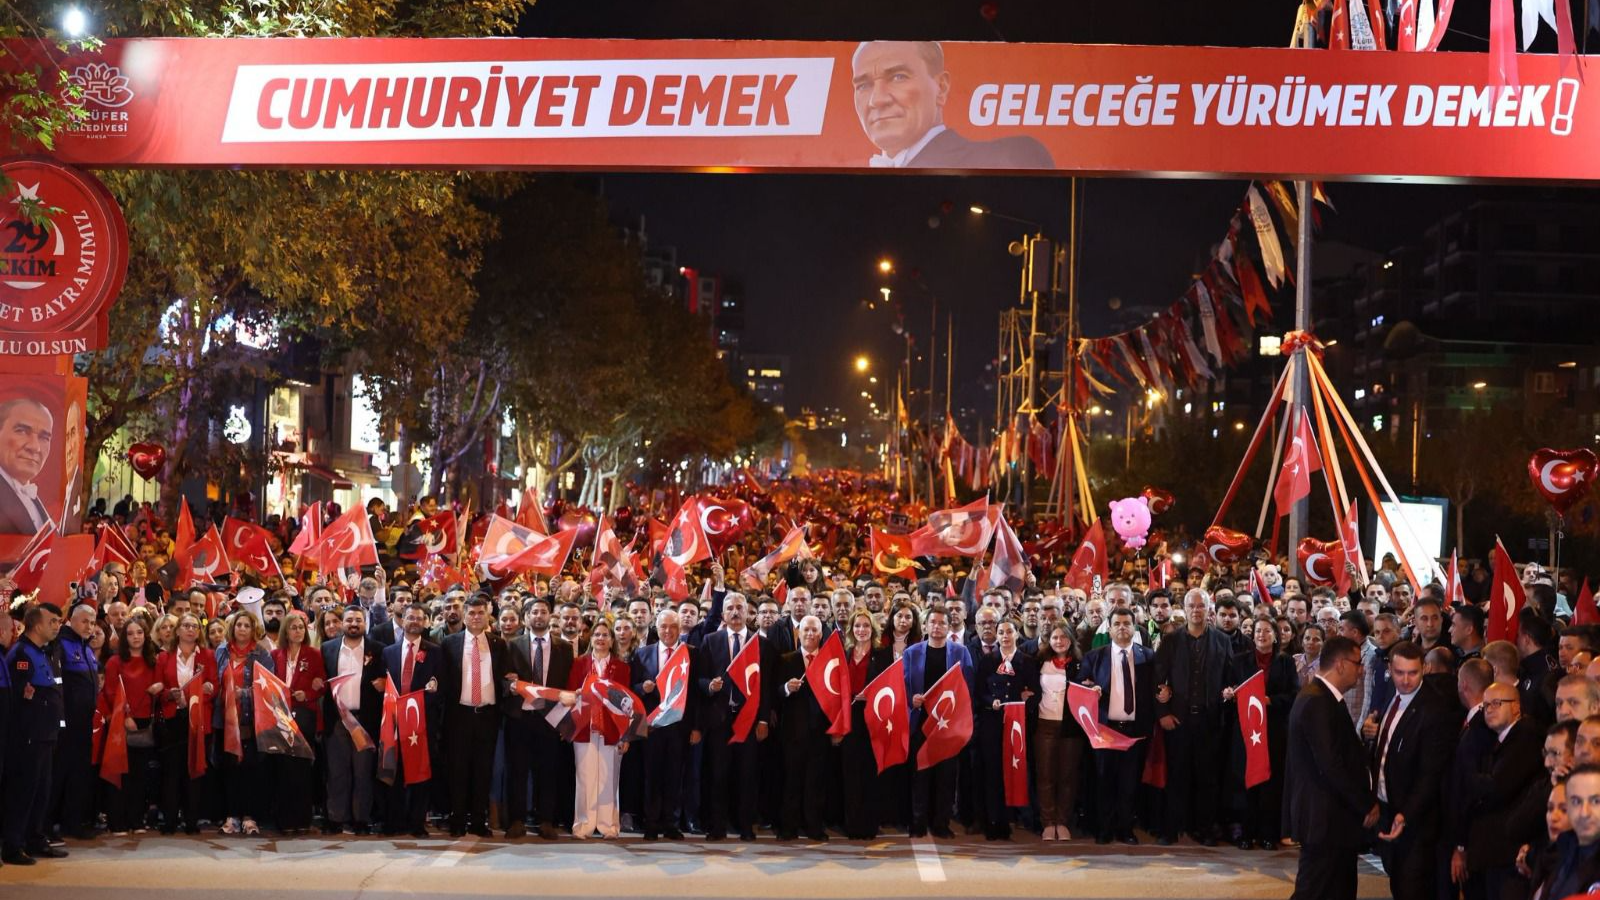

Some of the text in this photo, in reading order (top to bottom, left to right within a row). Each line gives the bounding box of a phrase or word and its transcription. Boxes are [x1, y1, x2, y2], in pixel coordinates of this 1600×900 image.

[256, 65, 798, 130] CUMHURİYET DEMEK
[968, 75, 1180, 127] GELECEĞE
[1191, 75, 1398, 127] YÜRÜMEK
[4, 219, 49, 254] 29
[30, 209, 97, 323] BAYRAMIMIZ
[26, 337, 87, 356] OLSUN
